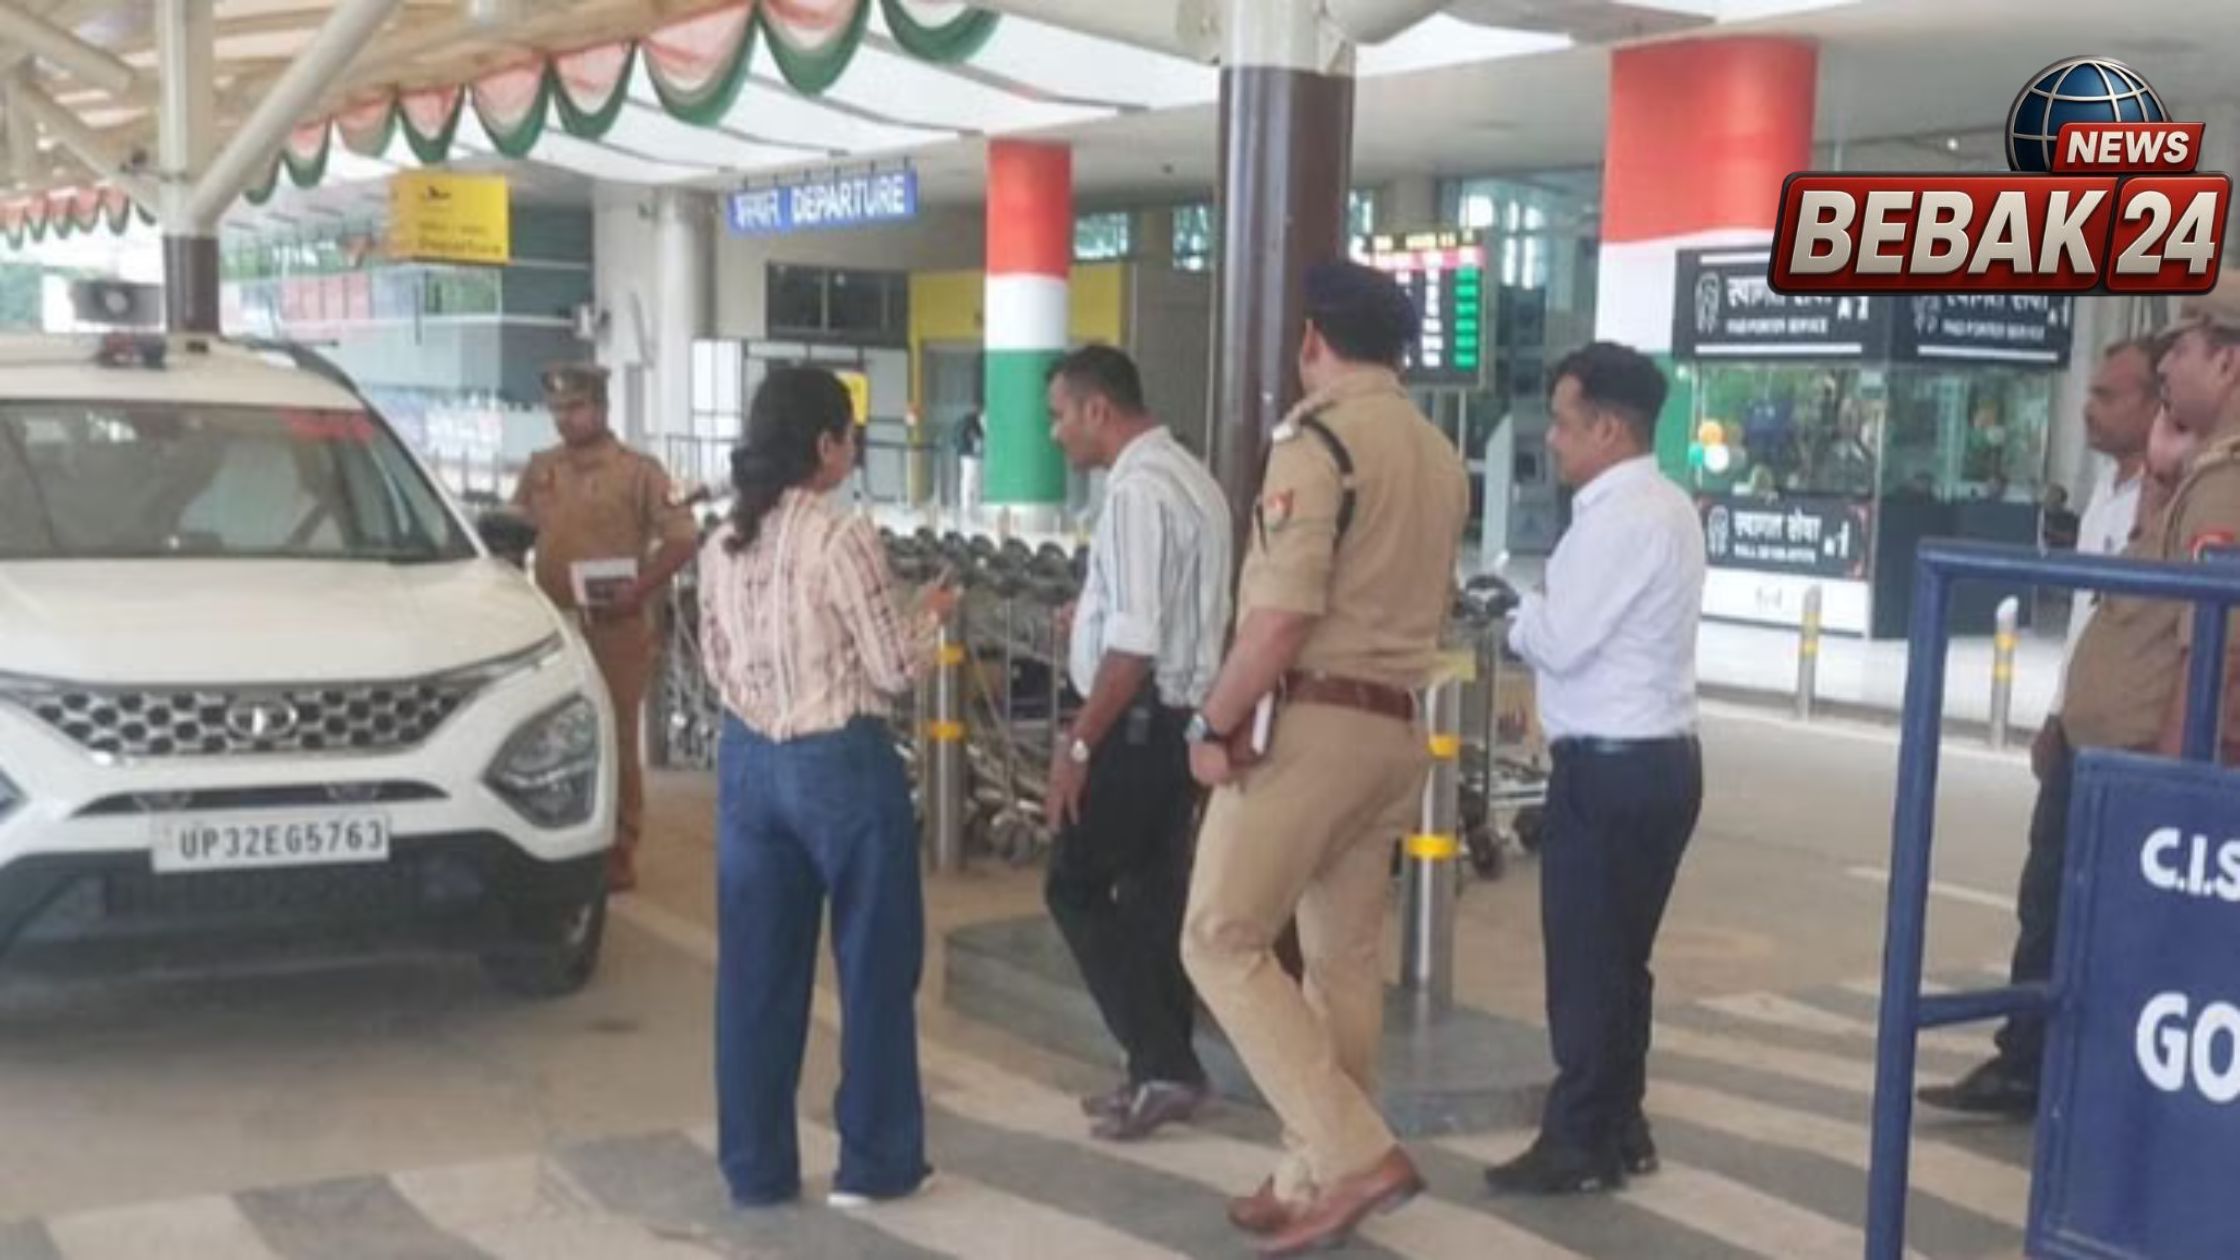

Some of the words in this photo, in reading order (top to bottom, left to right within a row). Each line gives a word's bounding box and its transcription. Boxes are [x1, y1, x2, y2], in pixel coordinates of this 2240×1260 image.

[791, 175, 905, 225] DEPARTURE
[1747, 317, 1786, 334] PORTER
[1787, 316, 1828, 334] SERVICE
[180, 820, 383, 860] UP32EG5763
[2135, 992, 2240, 1102] GO
